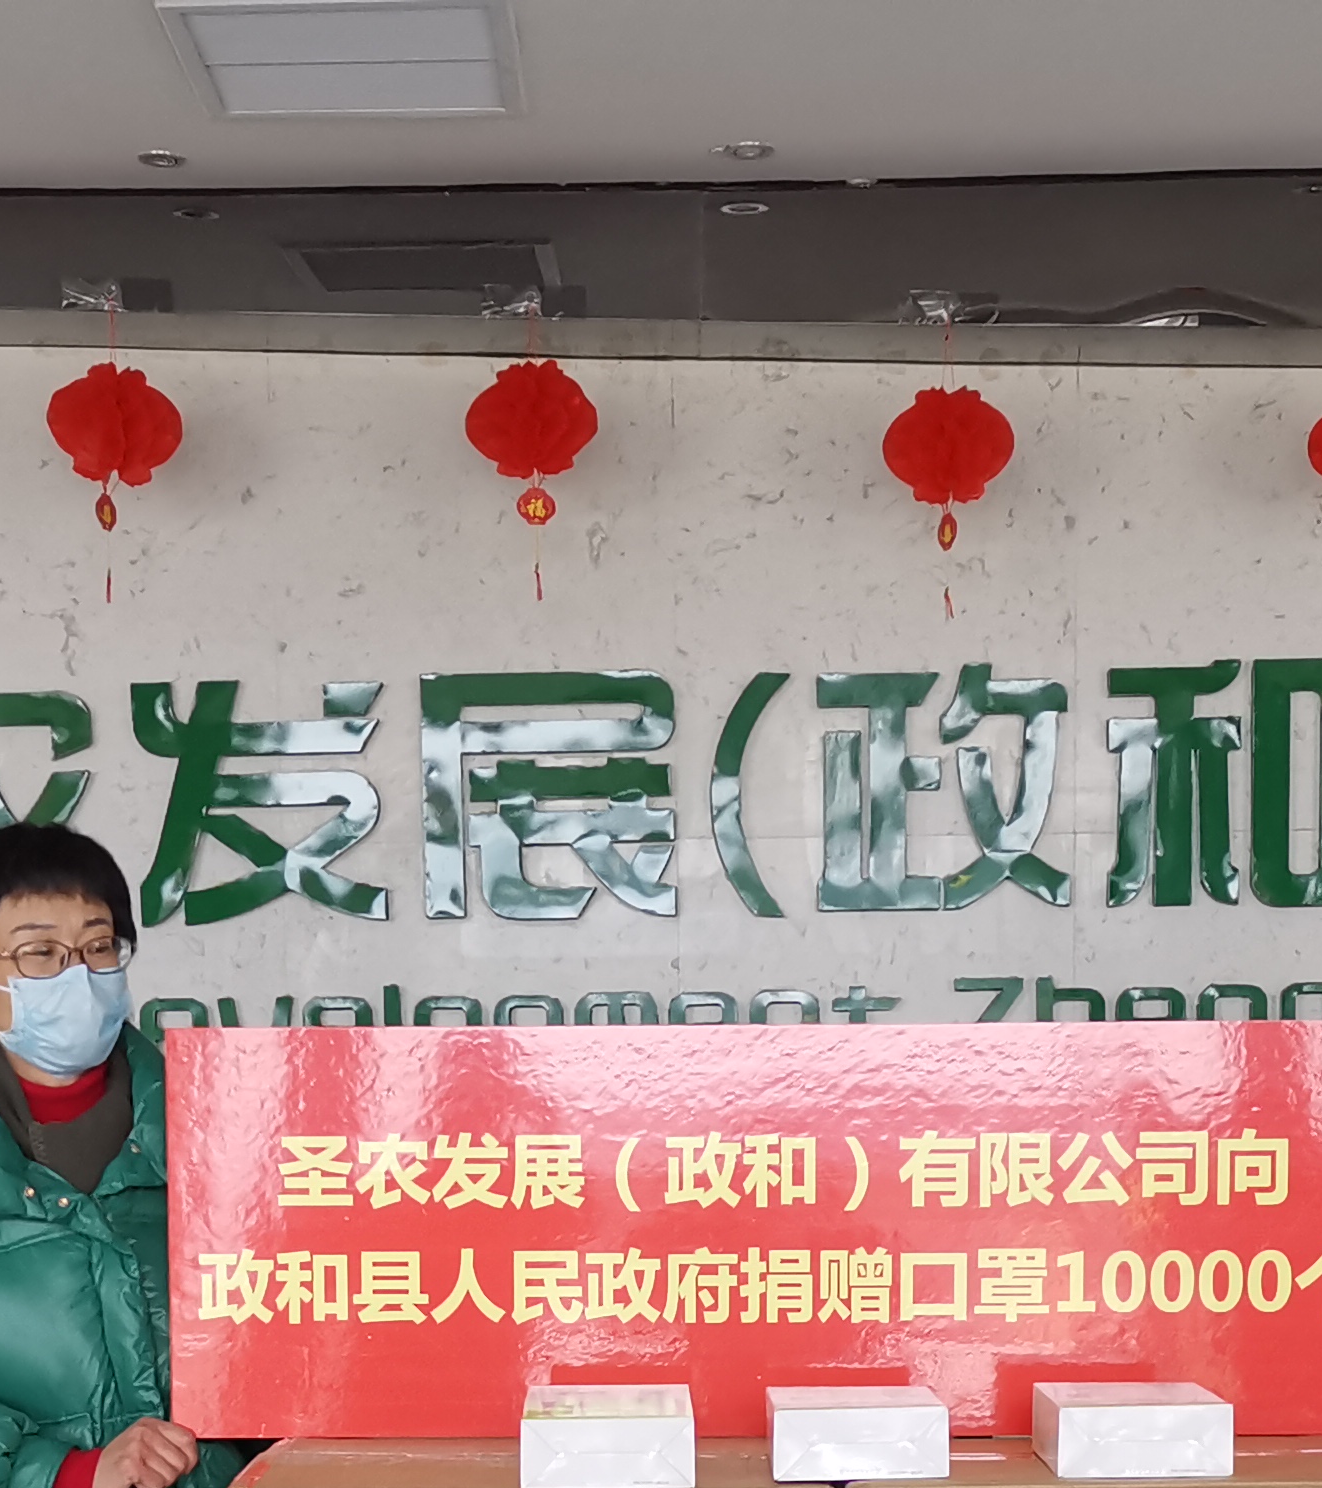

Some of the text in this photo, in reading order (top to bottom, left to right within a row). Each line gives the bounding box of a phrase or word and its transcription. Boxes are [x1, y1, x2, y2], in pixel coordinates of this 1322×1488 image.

[278, 1129, 1290, 1213] 圣农发展（政和）有限公司向
